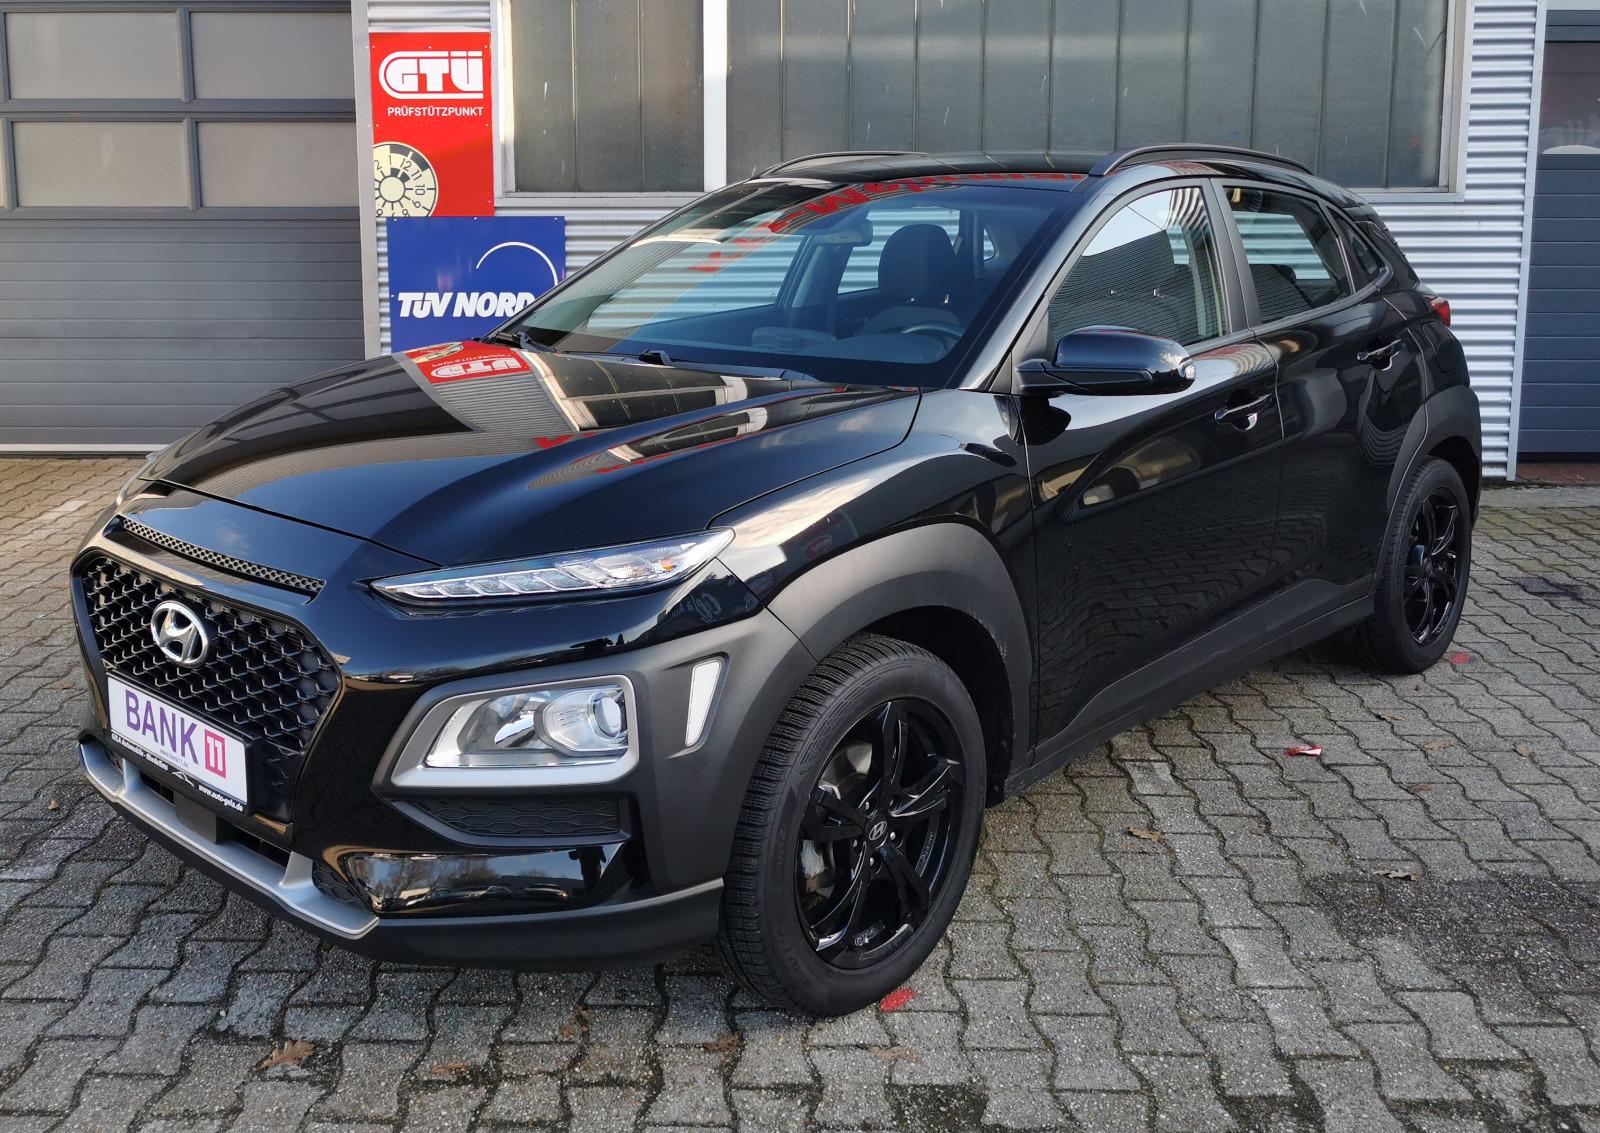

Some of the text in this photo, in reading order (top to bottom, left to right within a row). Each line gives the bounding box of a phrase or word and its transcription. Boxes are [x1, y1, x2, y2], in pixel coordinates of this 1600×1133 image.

[379, 51, 483, 99] GTÜ
[387, 105, 484, 117] PRÜFSTÜTZPUNKT
[400, 158, 412, 171] 12
[415, 184, 425, 195] 10
[398, 292, 453, 318] TÜV
[125, 689, 224, 775] BANK 11
